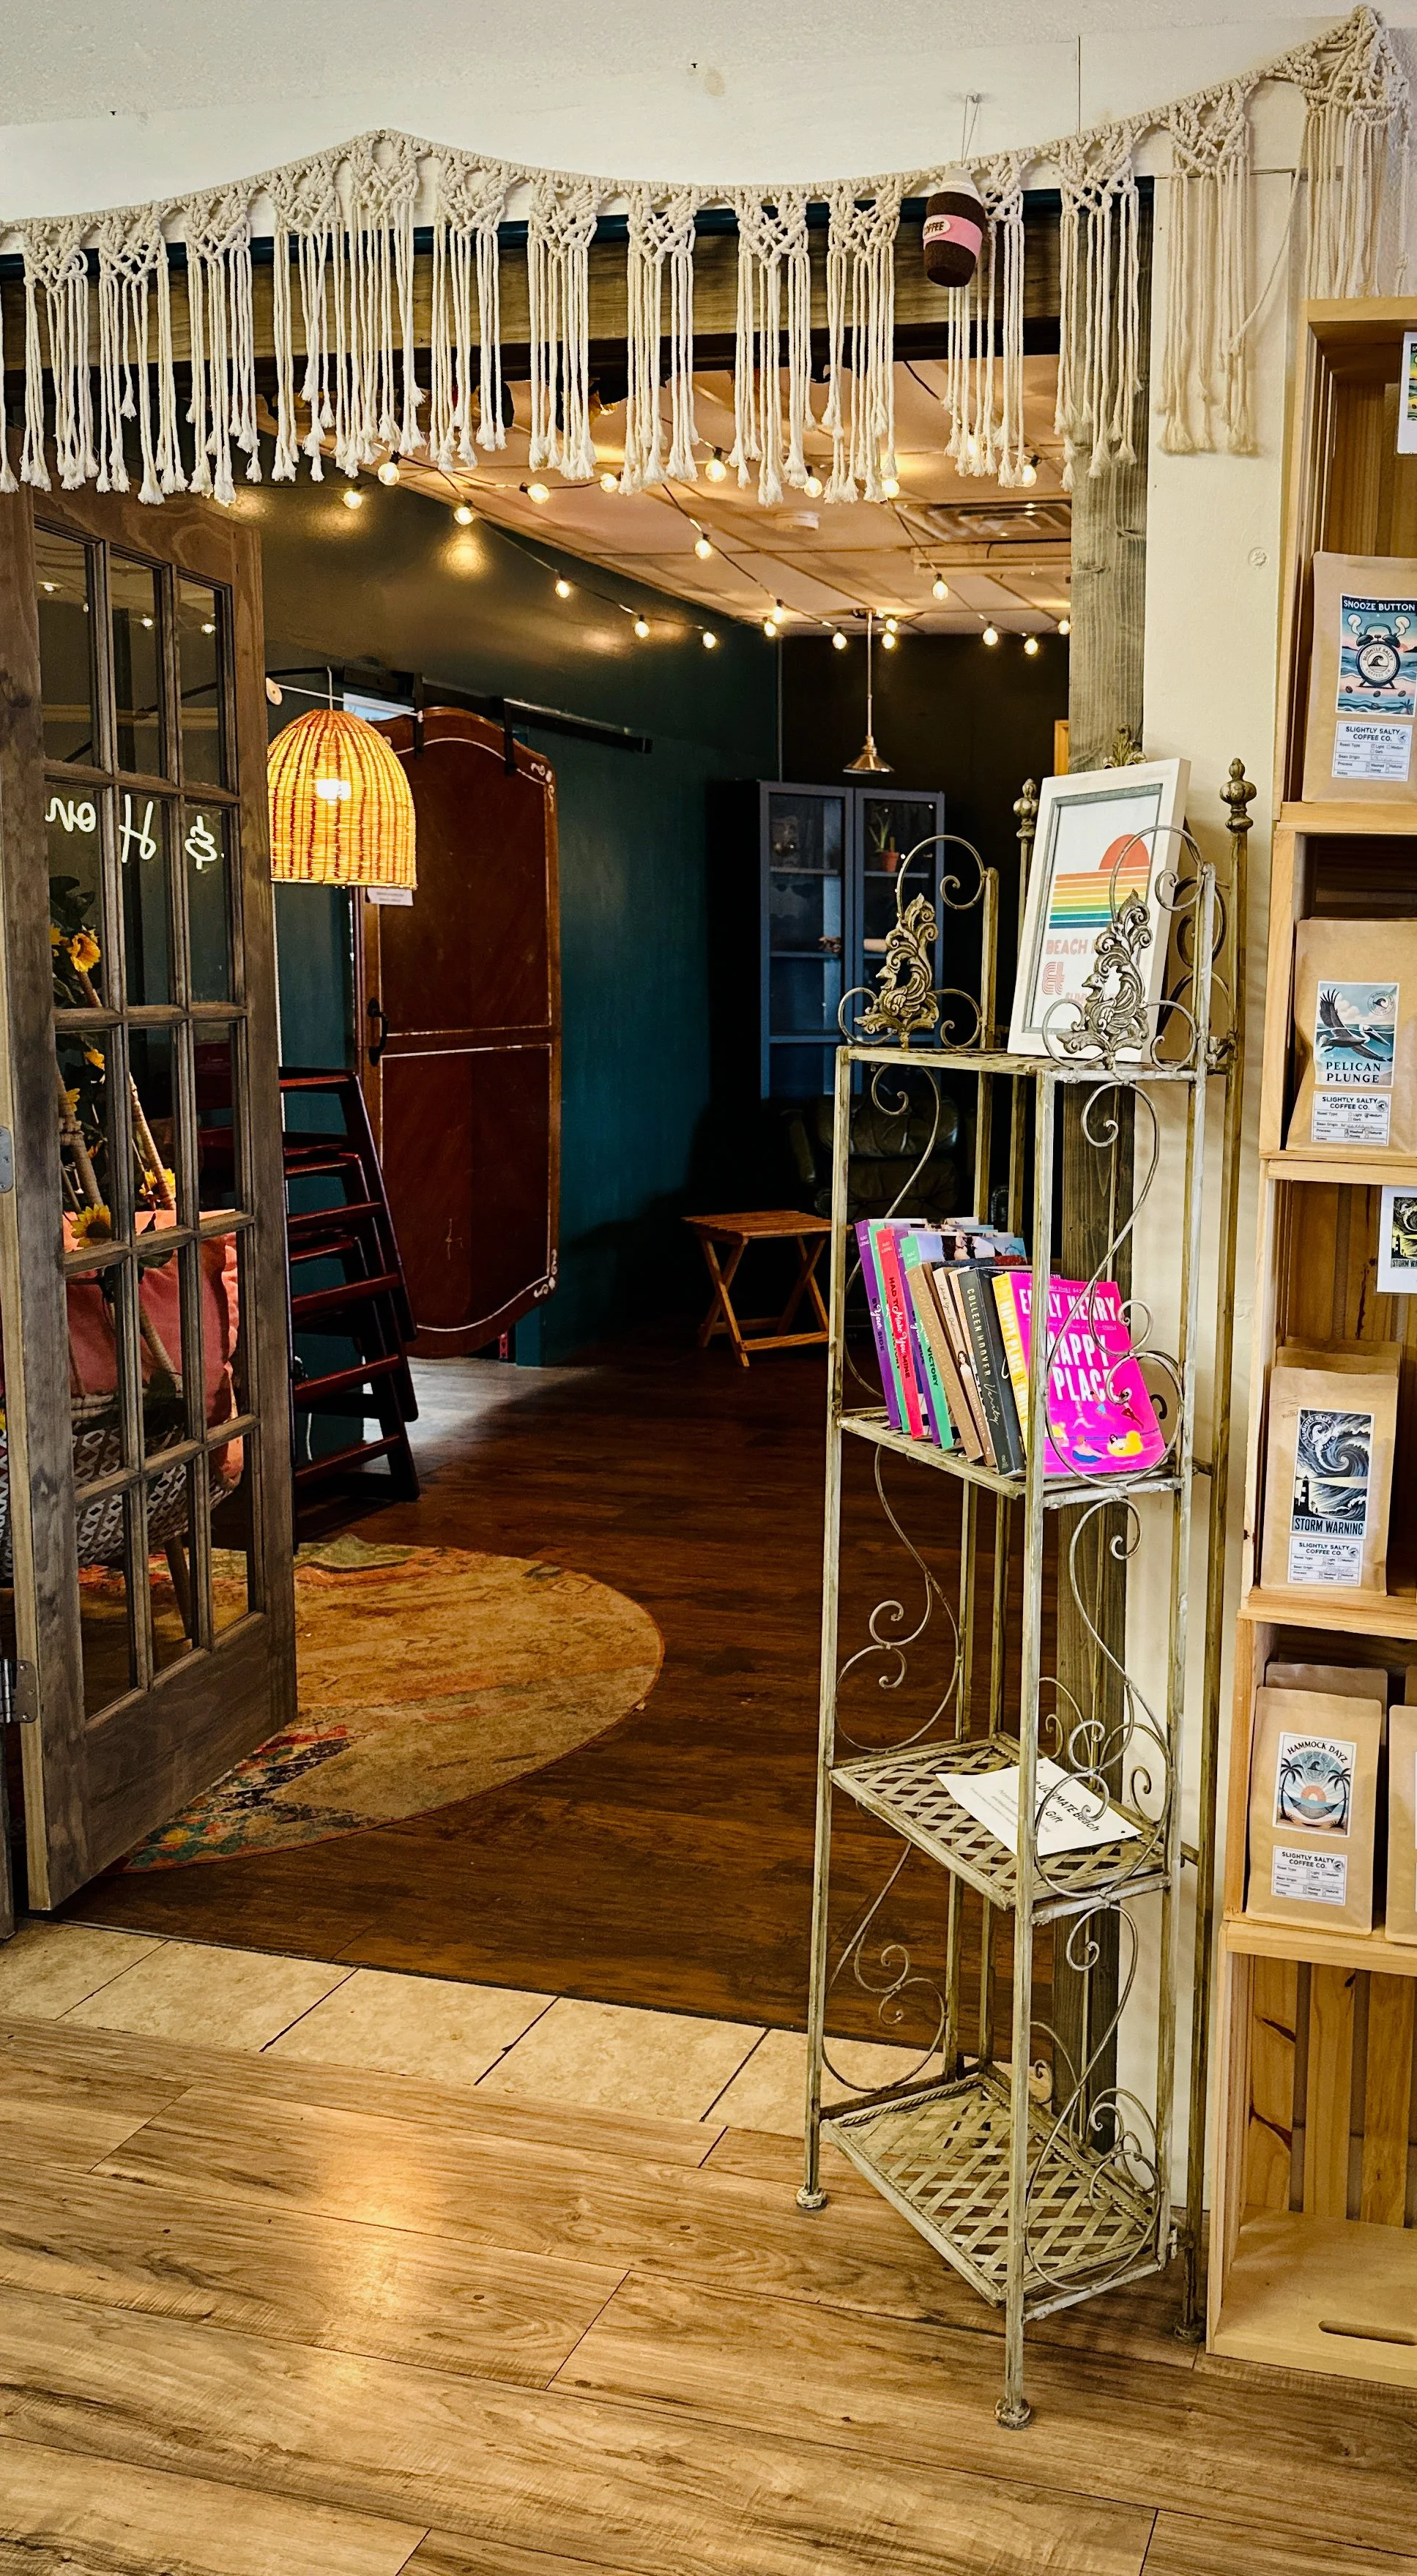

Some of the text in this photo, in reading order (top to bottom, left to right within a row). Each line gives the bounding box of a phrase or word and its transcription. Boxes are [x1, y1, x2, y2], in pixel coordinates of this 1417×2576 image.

[1343, 600, 1416, 611] SNOOZE BUTTON
[1345, 726, 1377, 734] SLIGHTLY
[1045, 938, 1087, 955] BEACH
[1326, 1061, 1381, 1072] PELICAN
[1326, 1073, 1380, 1083] PLUNGE
[1019, 1288, 1063, 1319] ELY
[967, 1288, 992, 1377] COLLEEN HOOVER
[901, 1355, 911, 1379] MINE
[926, 1346, 939, 1386] VICTORY
[983, 1383, 1000, 1426] Verity
[1295, 1517, 1364, 1535] STORM WARNING
[1287, 1741, 1348, 1764] HAMMOCK DAYZ
[1045, 1811, 1063, 1823] Gift
[1282, 1851, 1312, 1861] SLIGHTLY
[1289, 1858, 1314, 1867] COFFEE
